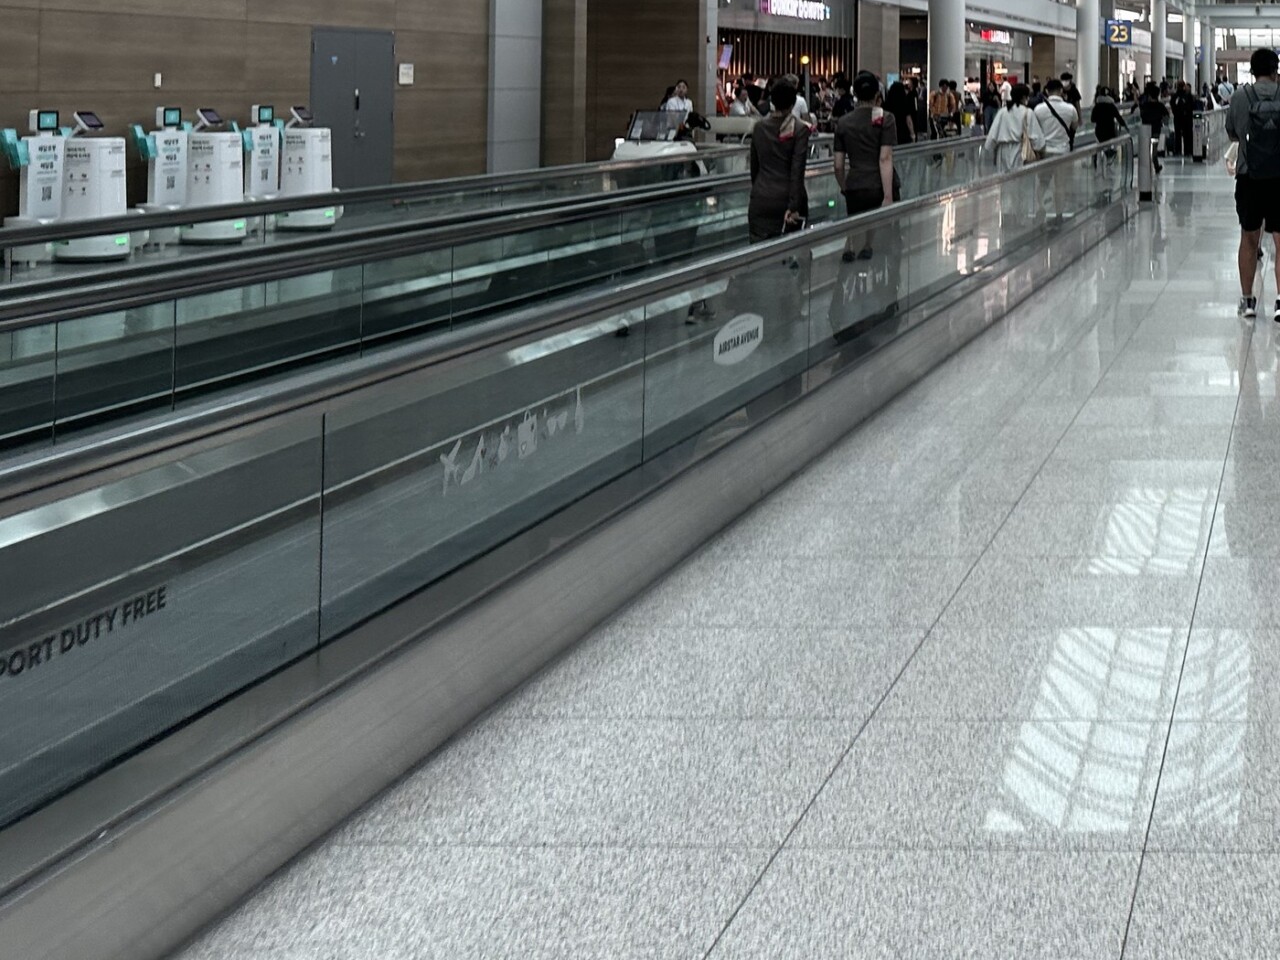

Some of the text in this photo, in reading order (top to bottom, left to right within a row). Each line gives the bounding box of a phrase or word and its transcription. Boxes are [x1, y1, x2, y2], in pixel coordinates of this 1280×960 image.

[1110, 24, 1128, 42] 23
[59, 607, 118, 655] DUTY
[122, 586, 168, 627] FREE
